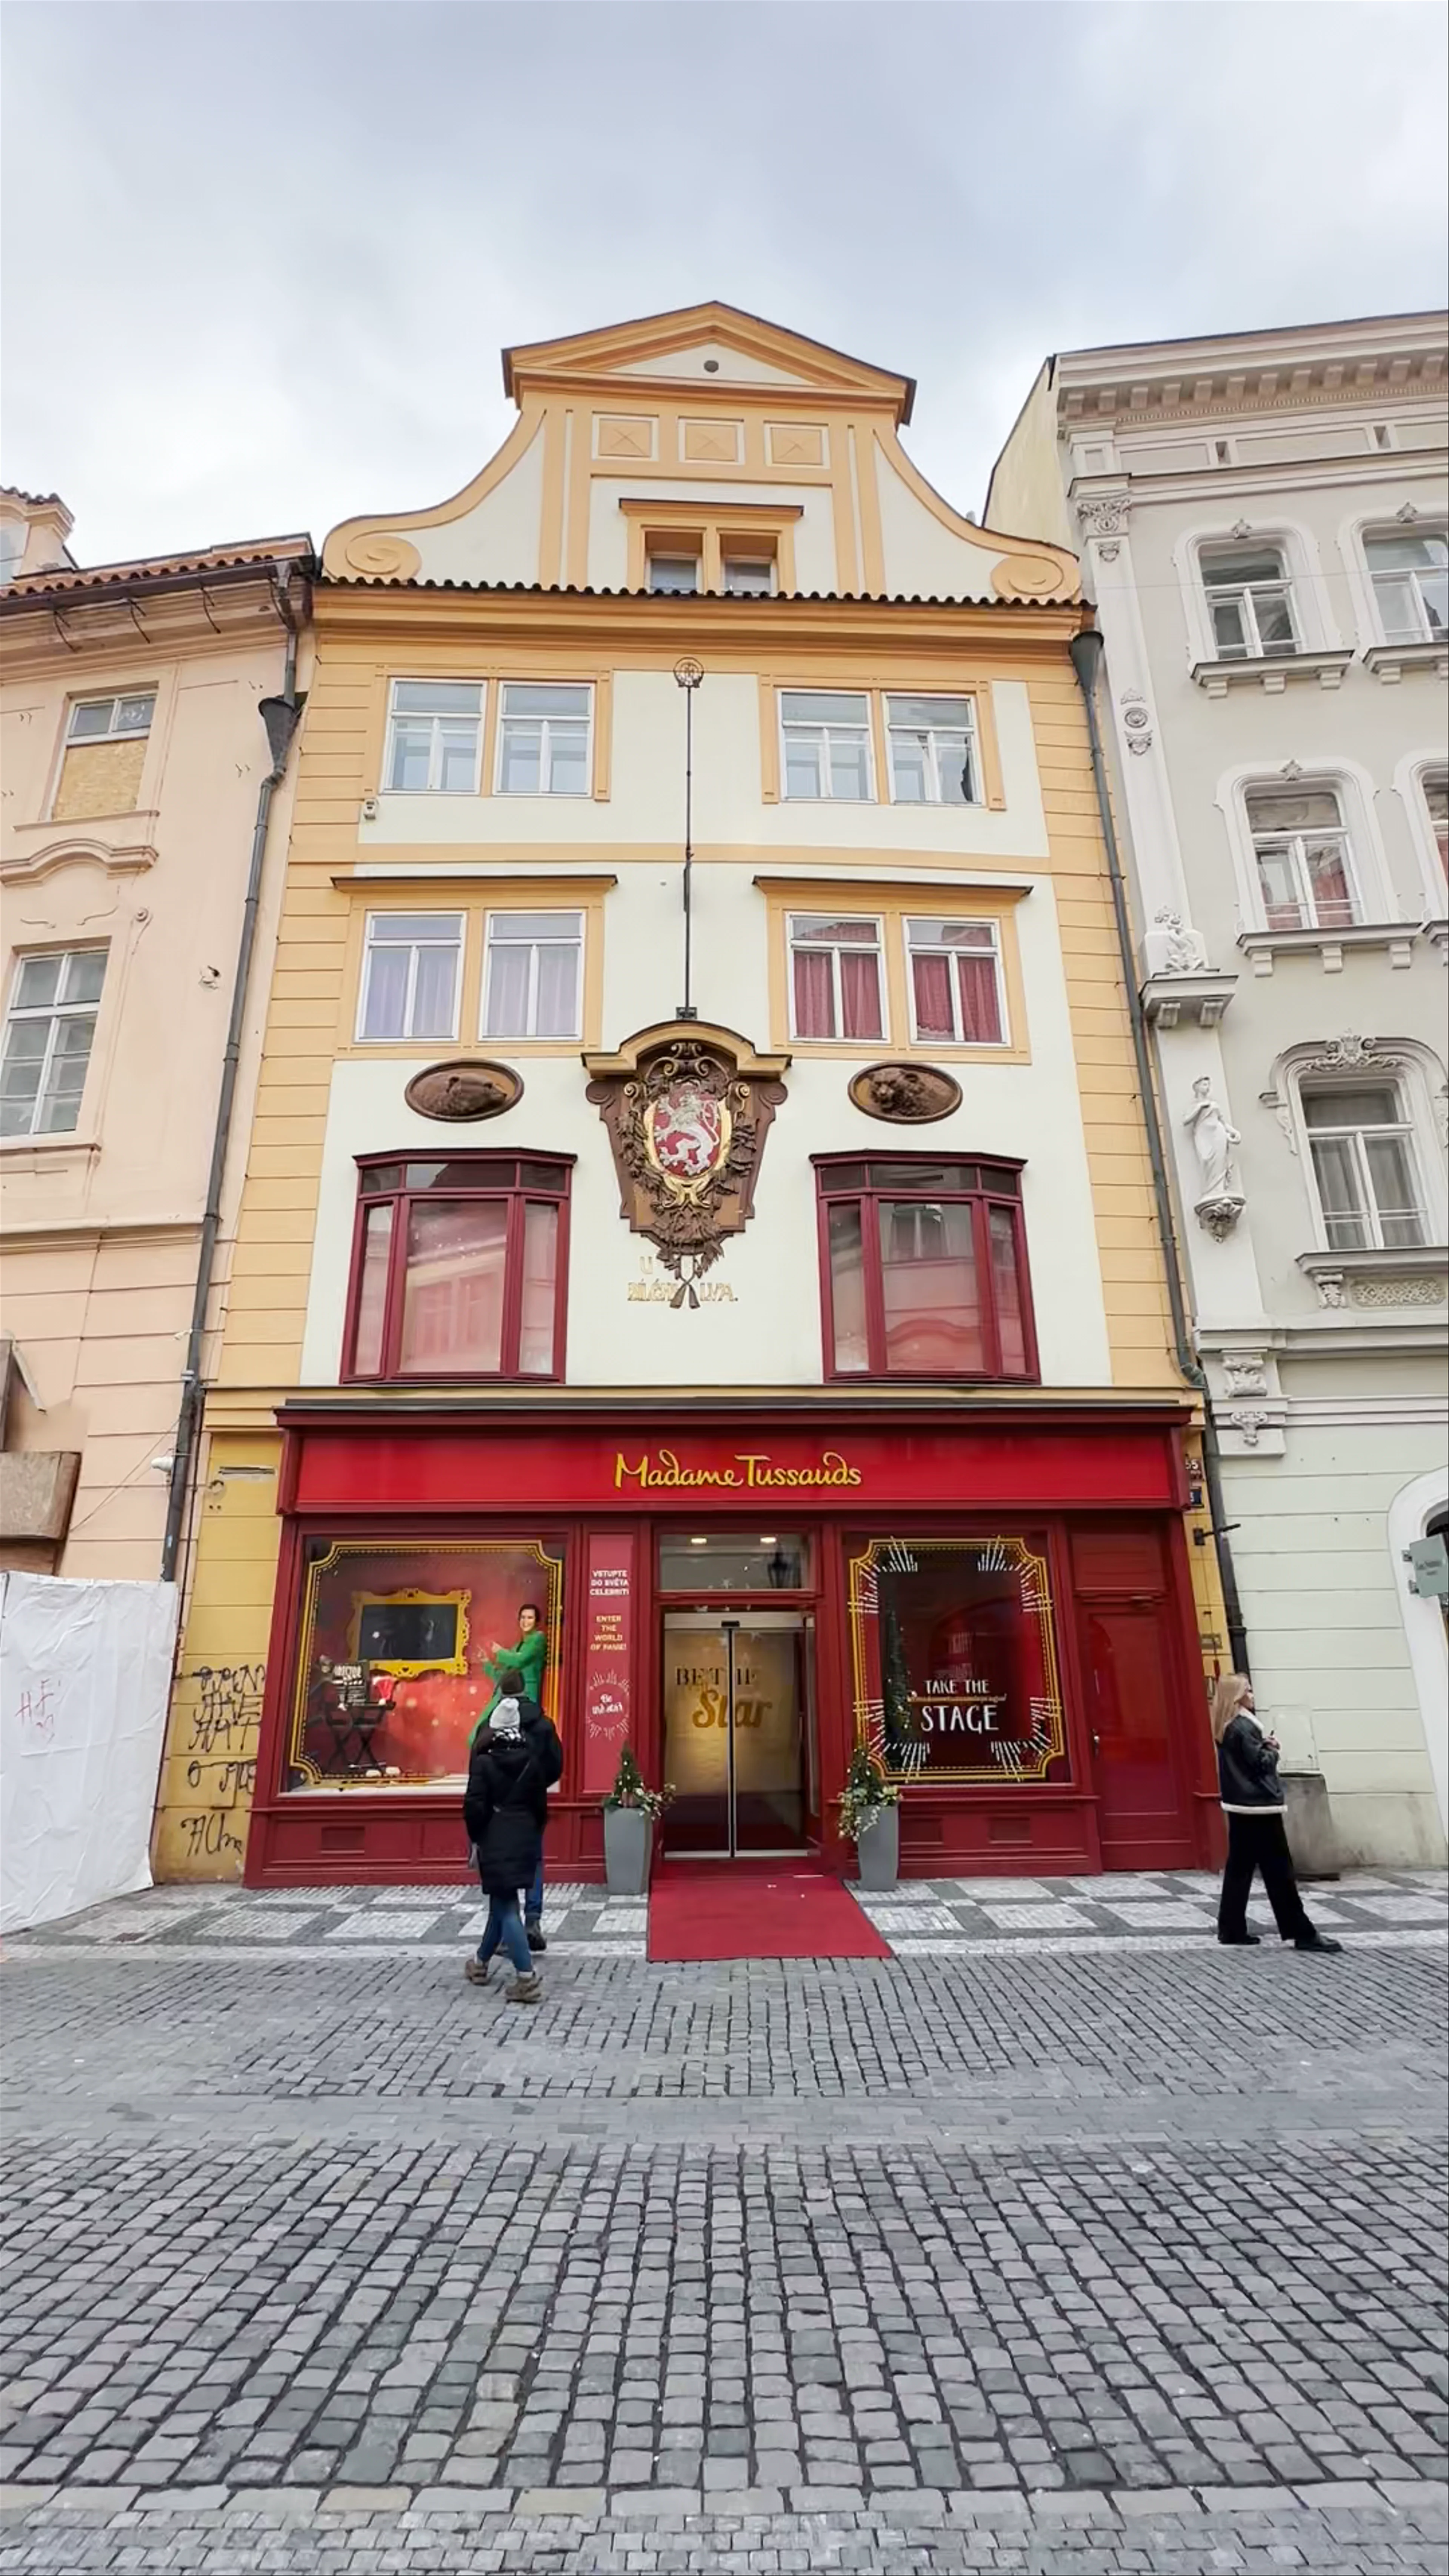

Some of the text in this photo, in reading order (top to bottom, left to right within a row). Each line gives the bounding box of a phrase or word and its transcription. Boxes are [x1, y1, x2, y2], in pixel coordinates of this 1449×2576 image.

[615, 1449, 861, 1487] Madame Tussauds
[924, 1679, 990, 1694] TAKE THE
[692, 1689, 773, 1728] Star
[921, 1704, 999, 1734] STAGE
